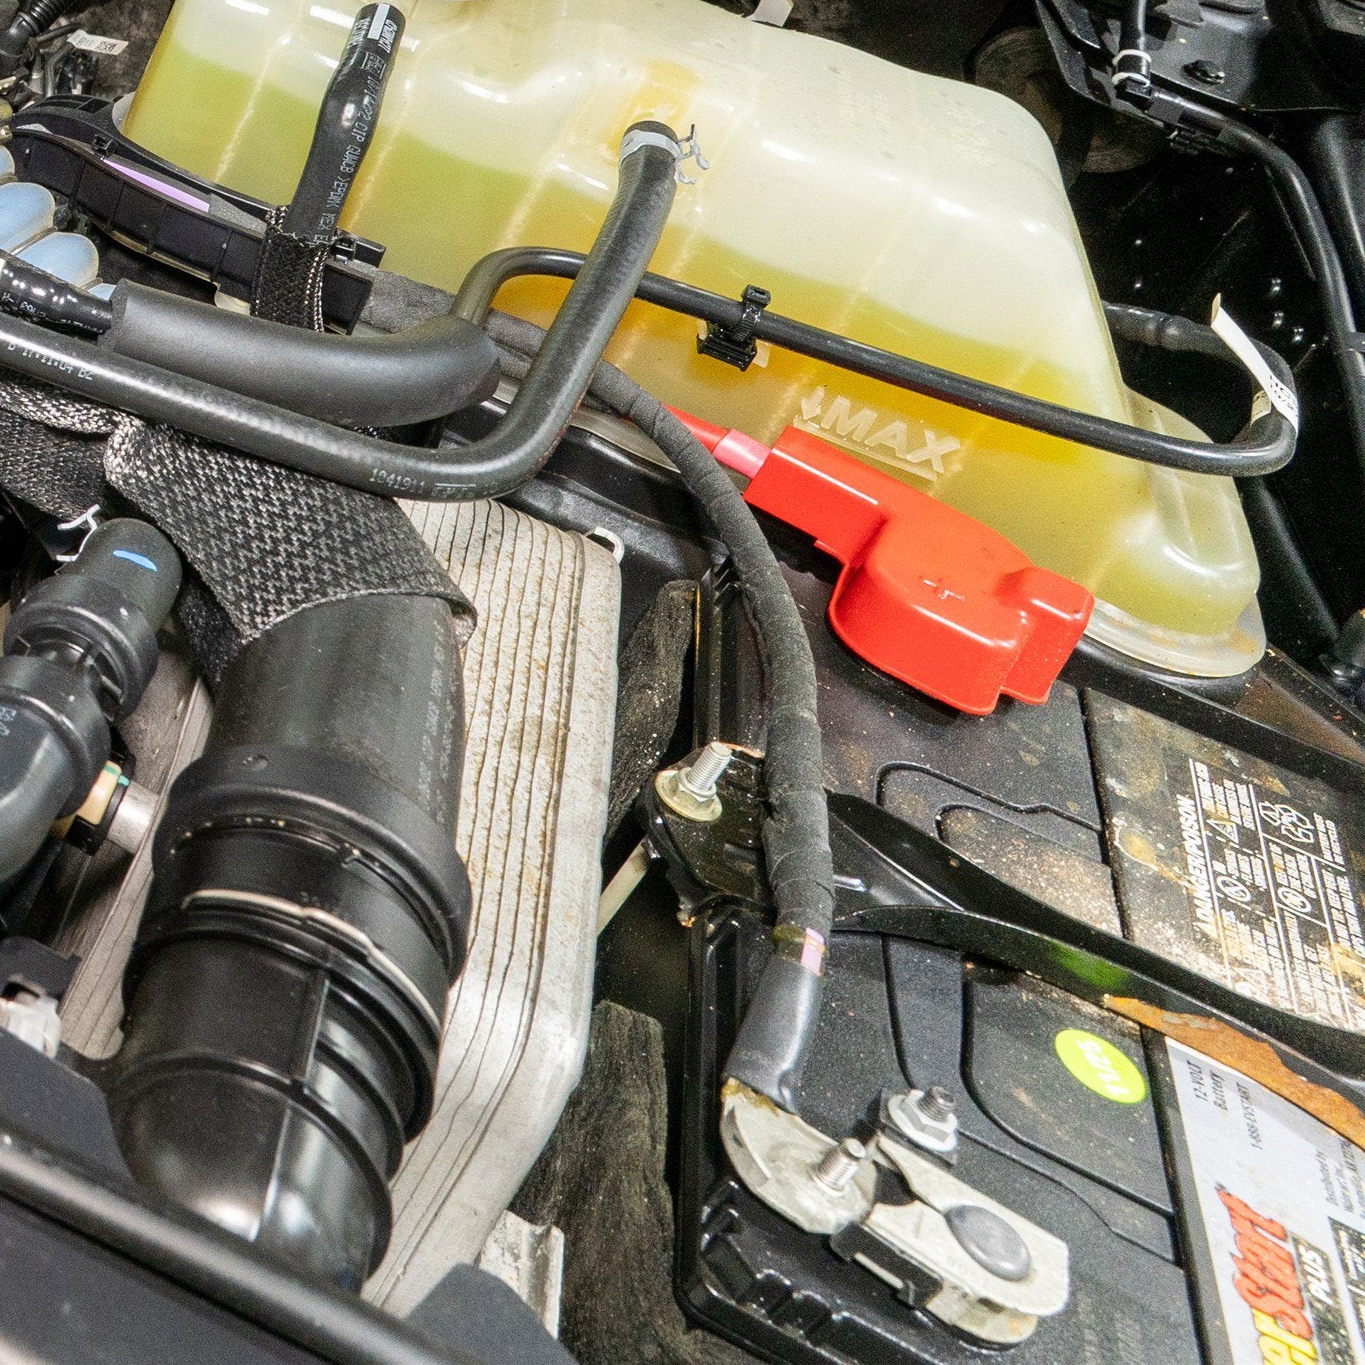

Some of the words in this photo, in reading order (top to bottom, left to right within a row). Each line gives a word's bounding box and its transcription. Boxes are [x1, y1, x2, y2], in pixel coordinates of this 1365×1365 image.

[821, 395, 961, 473] MAX
[1187, 1059, 1208, 1103] 12-VOLT
[1210, 1070, 1229, 1112] Battery
[1300, 1243, 1333, 1306] PLUS
